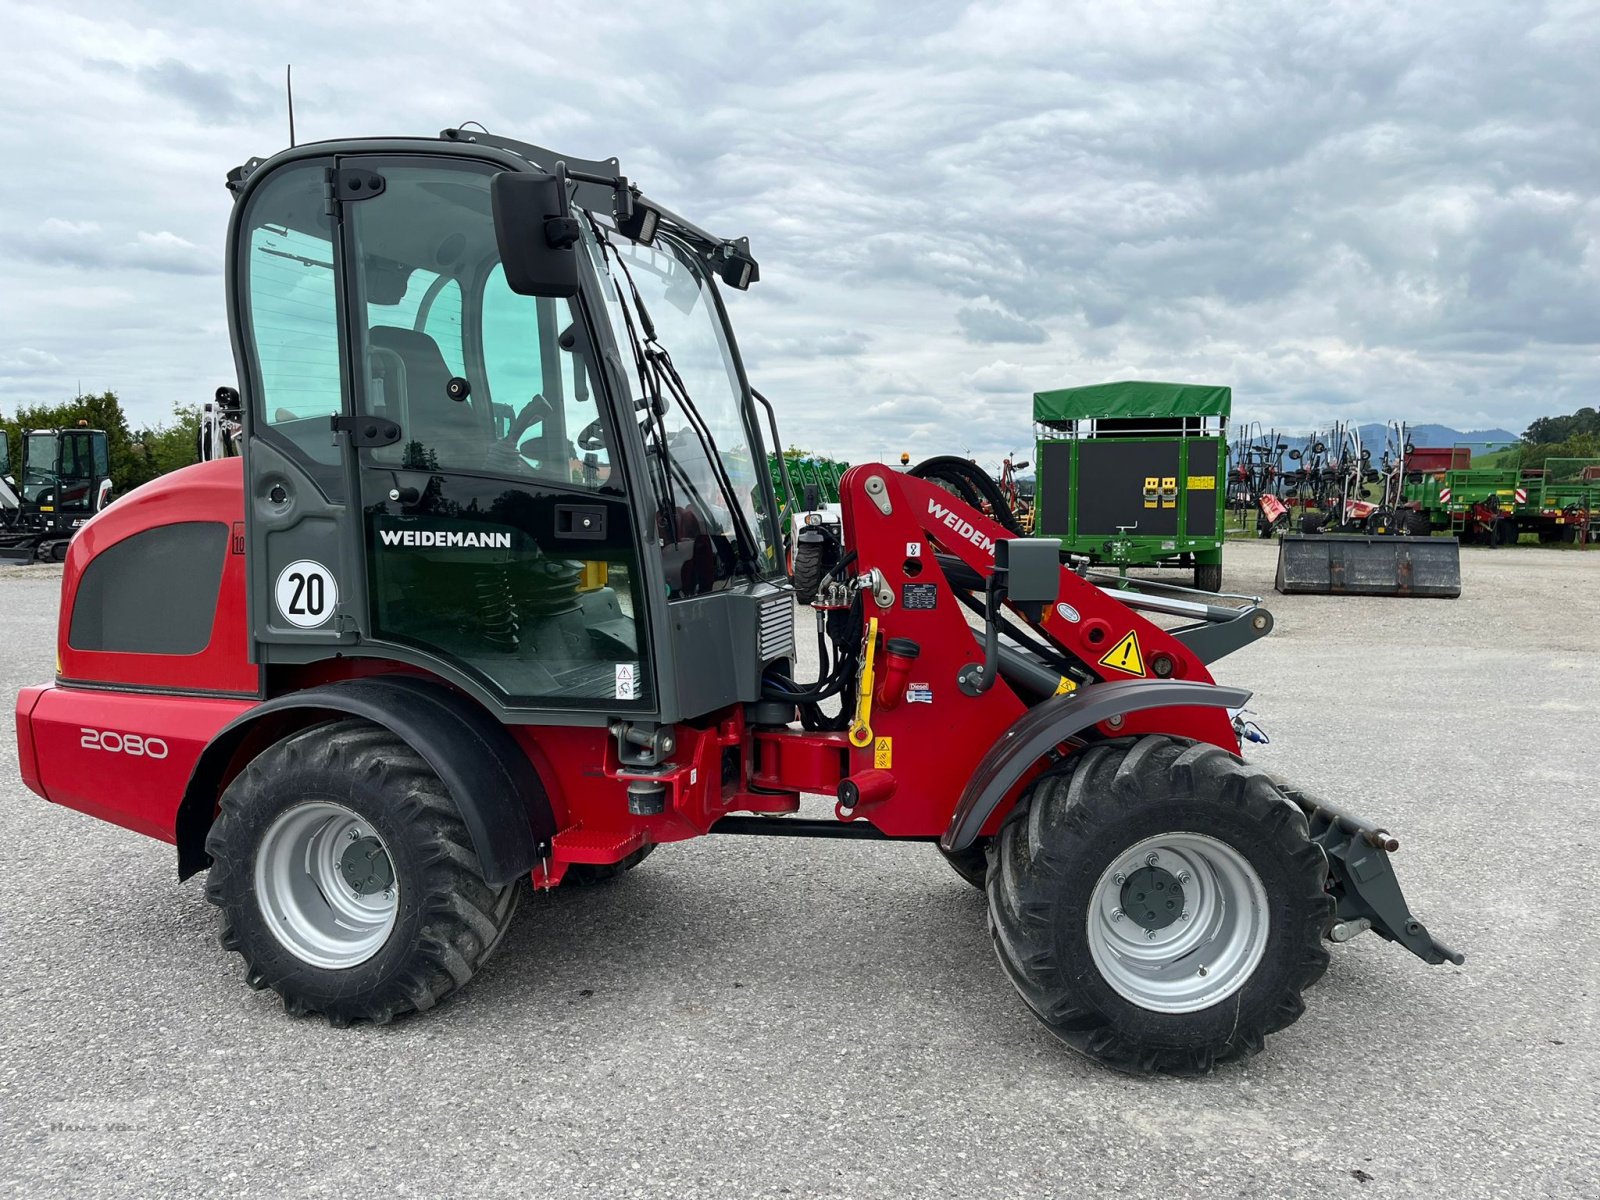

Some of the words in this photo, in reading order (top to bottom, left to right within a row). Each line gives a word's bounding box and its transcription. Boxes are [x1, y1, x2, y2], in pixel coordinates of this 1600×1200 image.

[379, 530, 511, 548] WEIDEMANN
[927, 497, 996, 559] WEIDEM
[288, 572, 324, 616] 20
[80, 727, 169, 760] 2080
